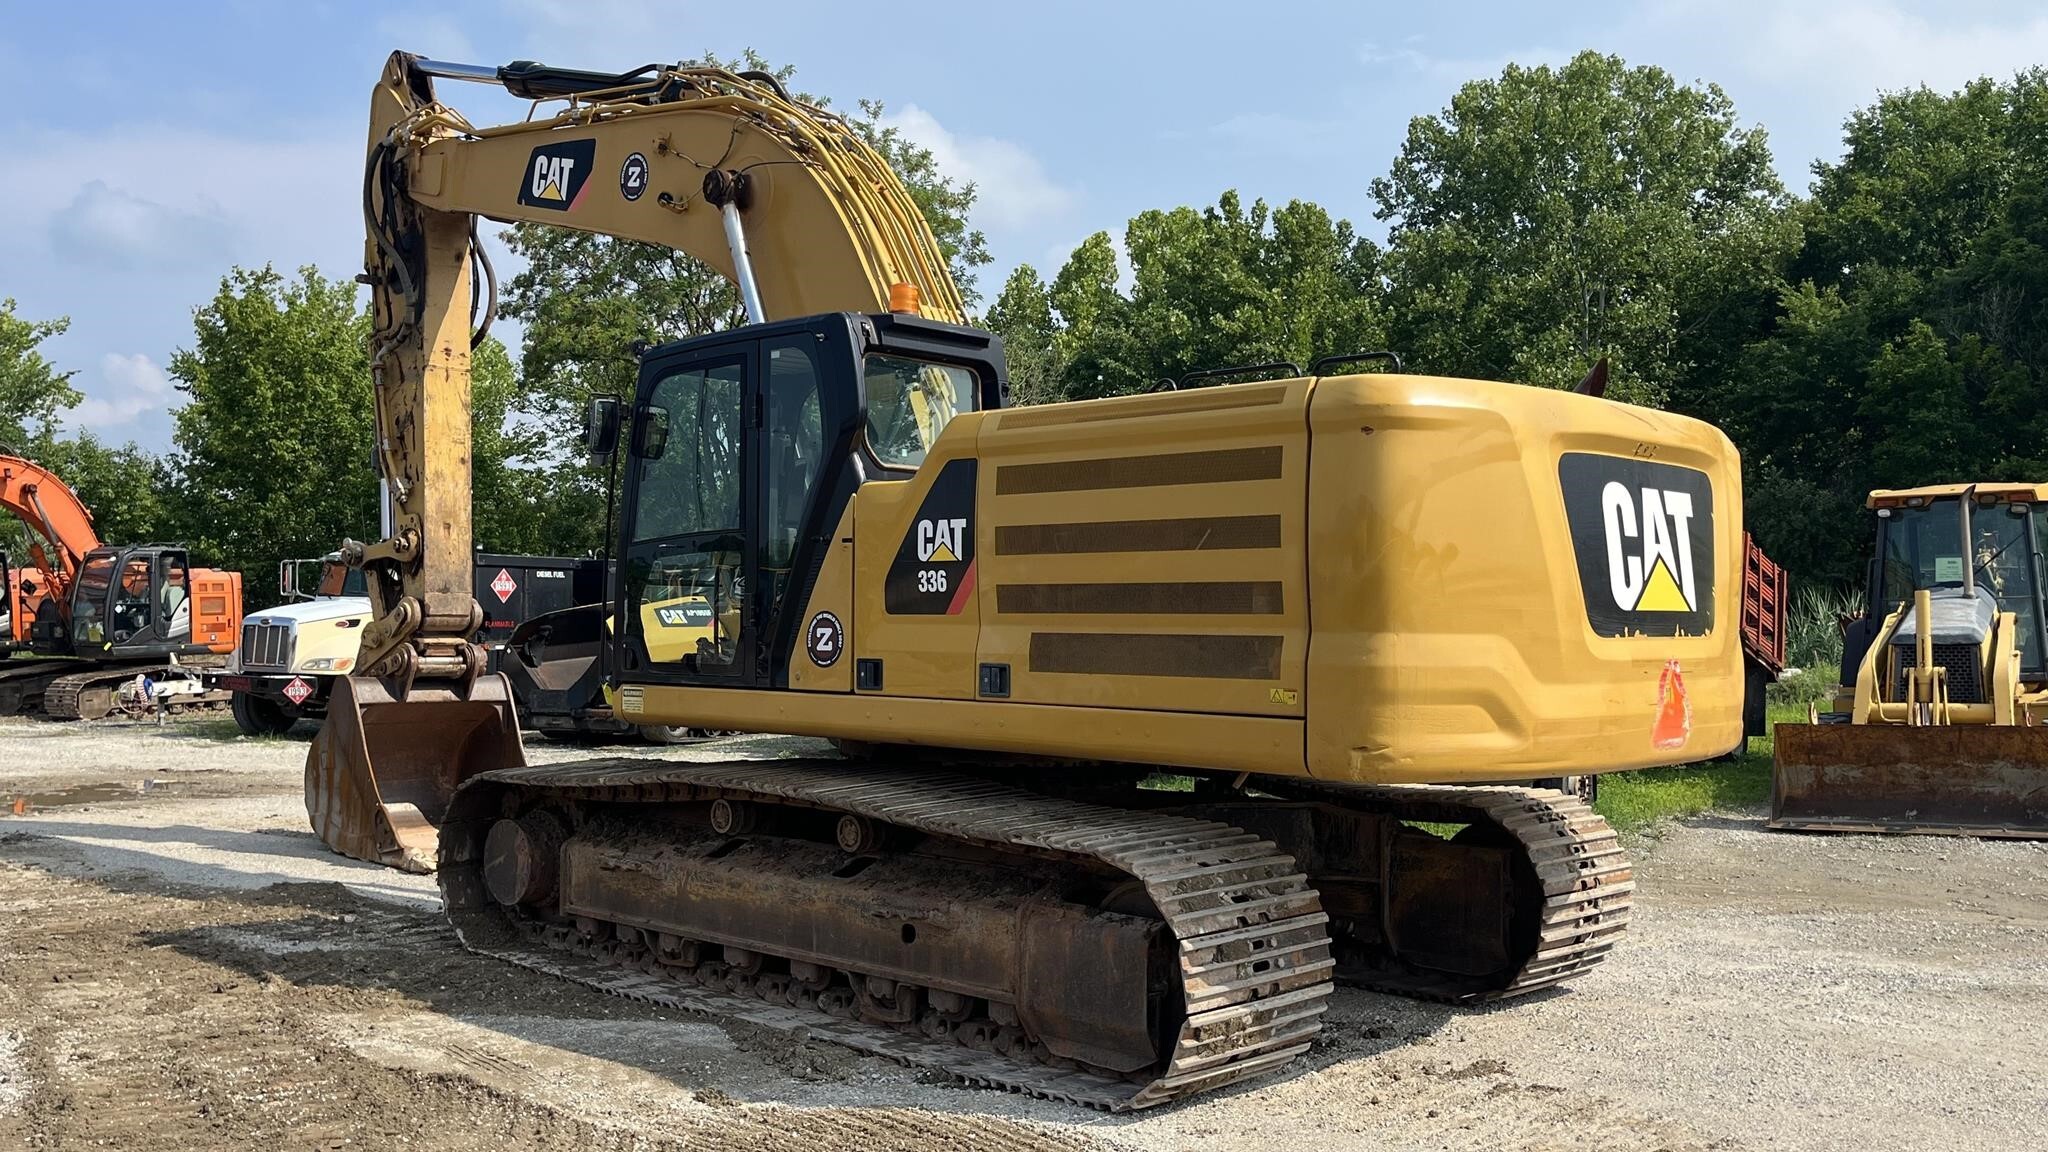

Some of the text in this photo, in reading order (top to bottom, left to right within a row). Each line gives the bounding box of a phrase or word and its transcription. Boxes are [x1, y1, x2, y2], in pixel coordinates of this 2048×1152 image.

[532, 155, 574, 201] CAT
[628, 166, 641, 187] Z
[917, 518, 967, 562] CAT
[1601, 481, 1697, 612] CAT
[918, 569, 947, 593] 336
[660, 609, 688, 624] CAT
[816, 627, 833, 651] Z
[290, 687, 306, 696] 1993
